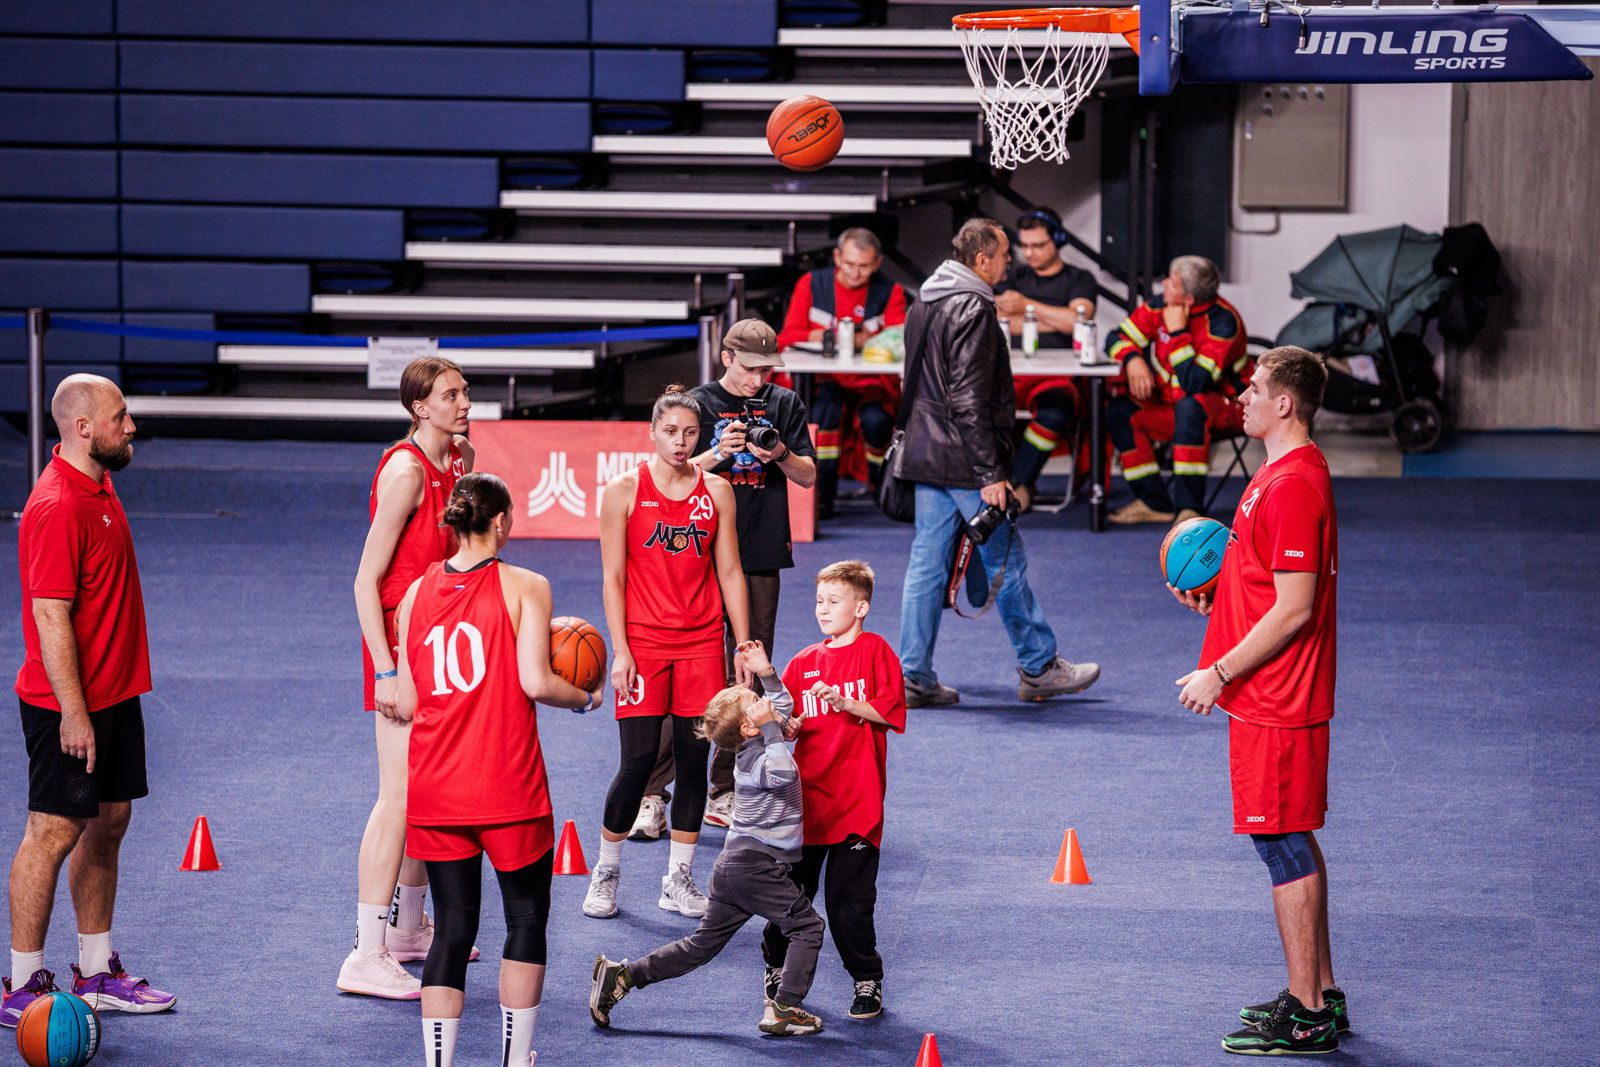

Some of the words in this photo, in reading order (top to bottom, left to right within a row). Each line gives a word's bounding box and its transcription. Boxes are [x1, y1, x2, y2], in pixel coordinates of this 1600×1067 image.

[1294, 28, 1509, 55] JINLING
[1414, 56, 1506, 70] SPORTS
[688, 494, 714, 521] 29
[1200, 548, 1216, 566] FIBA
[423, 621, 486, 696] 10
